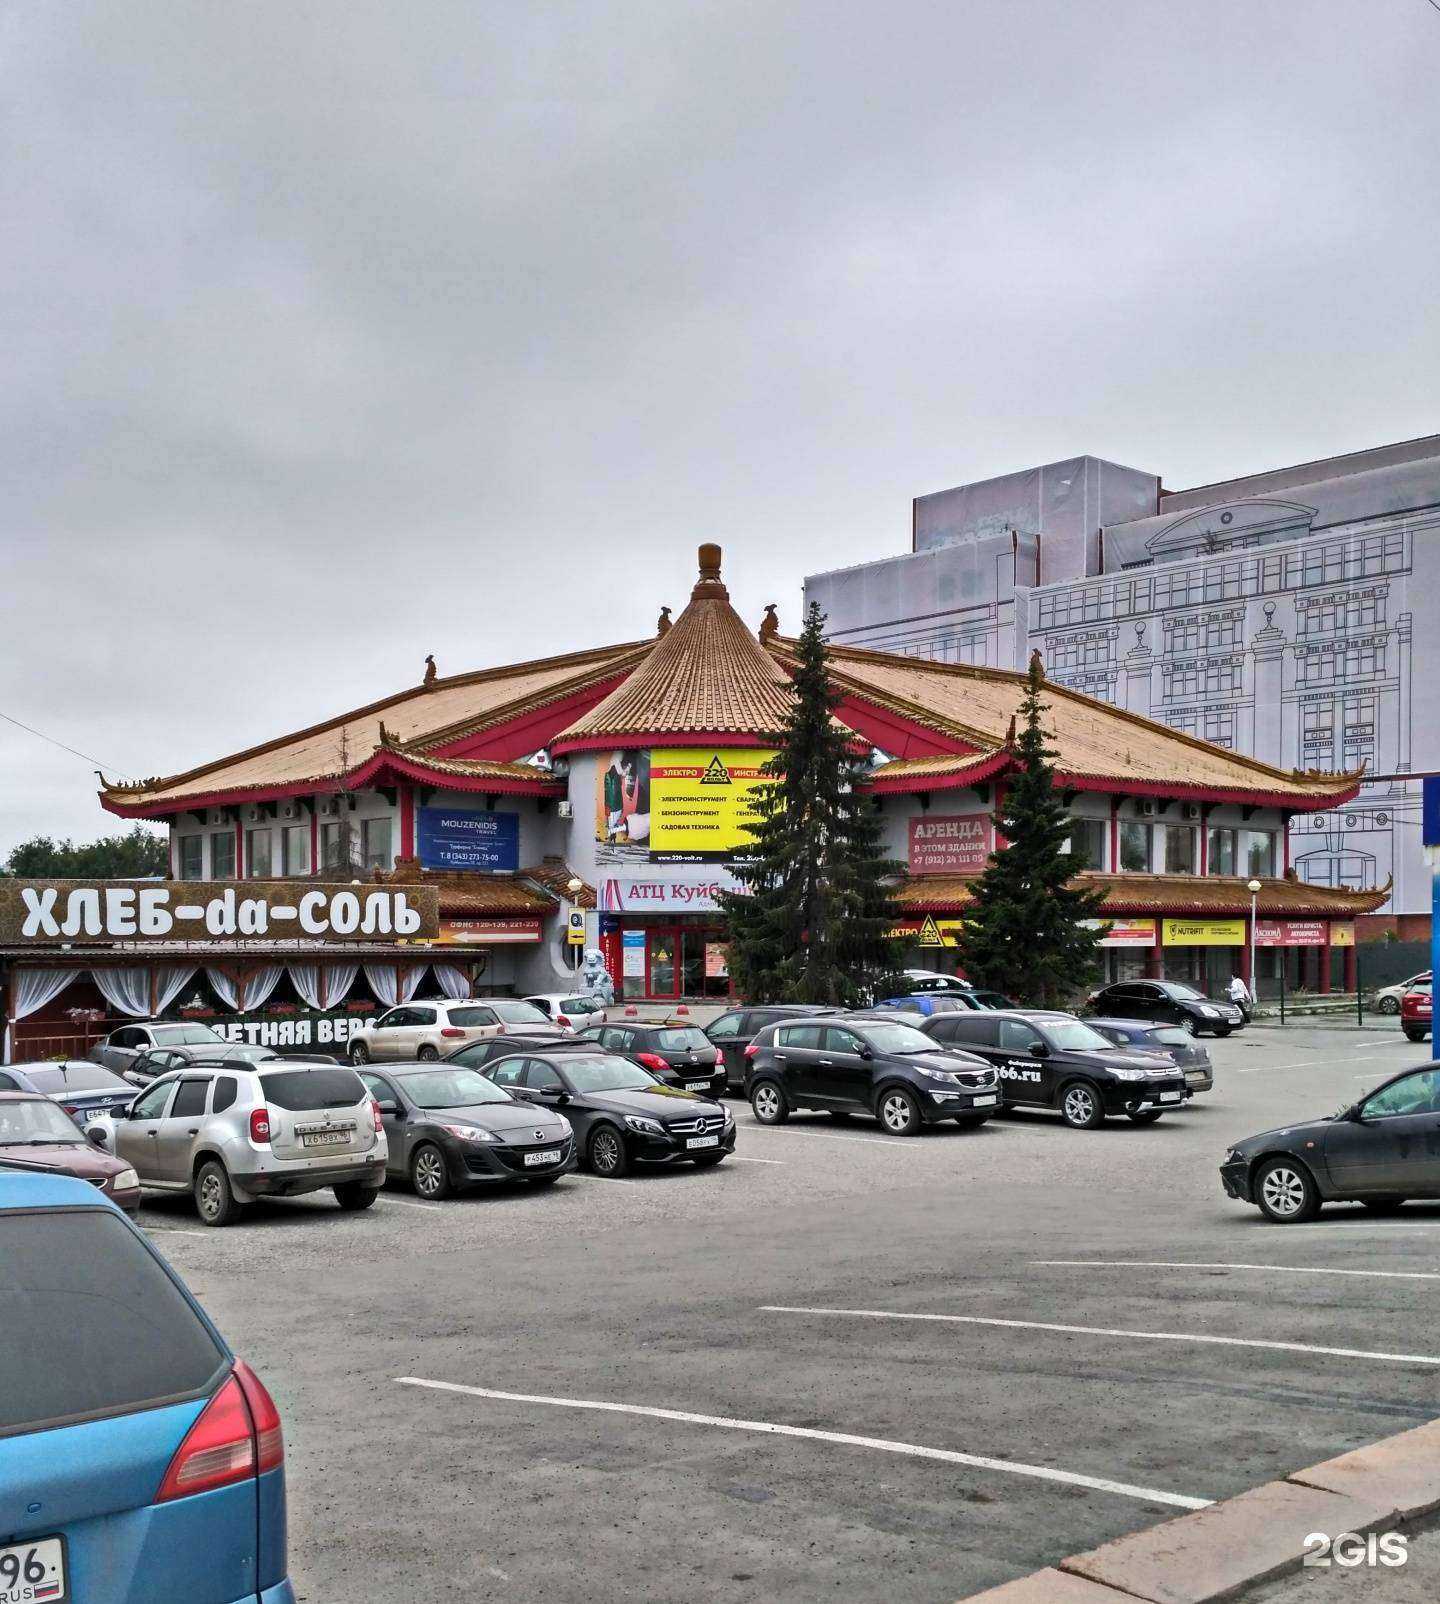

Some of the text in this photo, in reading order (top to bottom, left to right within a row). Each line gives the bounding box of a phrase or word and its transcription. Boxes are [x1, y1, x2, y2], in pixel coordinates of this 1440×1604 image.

[662, 769, 698, 777] ЭЛЕКТРО
[704, 768, 728, 777] 220
[441, 819, 498, 831] MOUZENIDIS
[914, 820, 984, 839] АРЕНДА
[920, 844, 946, 853] ЭТОМ
[947, 842, 986, 853] ЗДАНИИ
[452, 852, 468, 860] (343)
[656, 854, 703, 862] www.220-volt.ru
[913, 856, 923, 864] +7
[925, 855, 945, 866] (912)
[628, 884, 665, 901] АТЦ
[21, 888, 420, 937] ХЛЕБ-da-СОЛЬ
[1177, 927, 1205, 935] NUTRIFIT
[0, 1548, 46, 1590] 96
